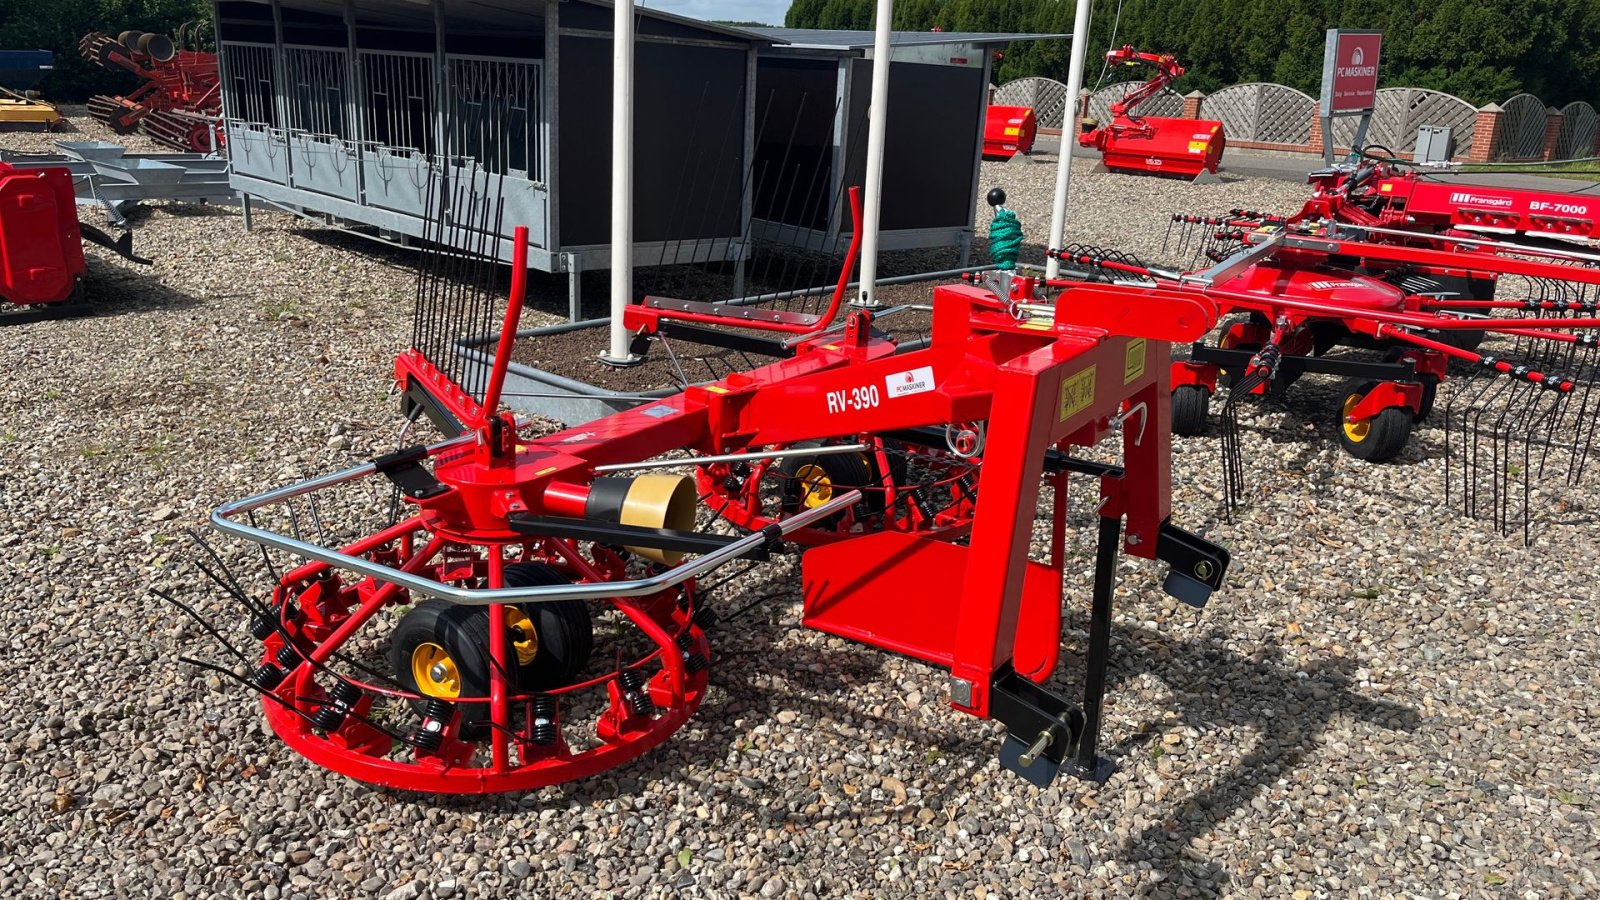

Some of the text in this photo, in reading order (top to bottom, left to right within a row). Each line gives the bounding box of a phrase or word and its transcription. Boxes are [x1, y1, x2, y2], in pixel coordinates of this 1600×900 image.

[1337, 66, 1375, 77] PC MASKINER
[1469, 196, 1513, 206] Fransgård
[1529, 201, 1587, 215] BF-7000
[896, 385, 903, 393] PC
[902, 381, 925, 391] MASKINER
[826, 384, 880, 414] RV-390
